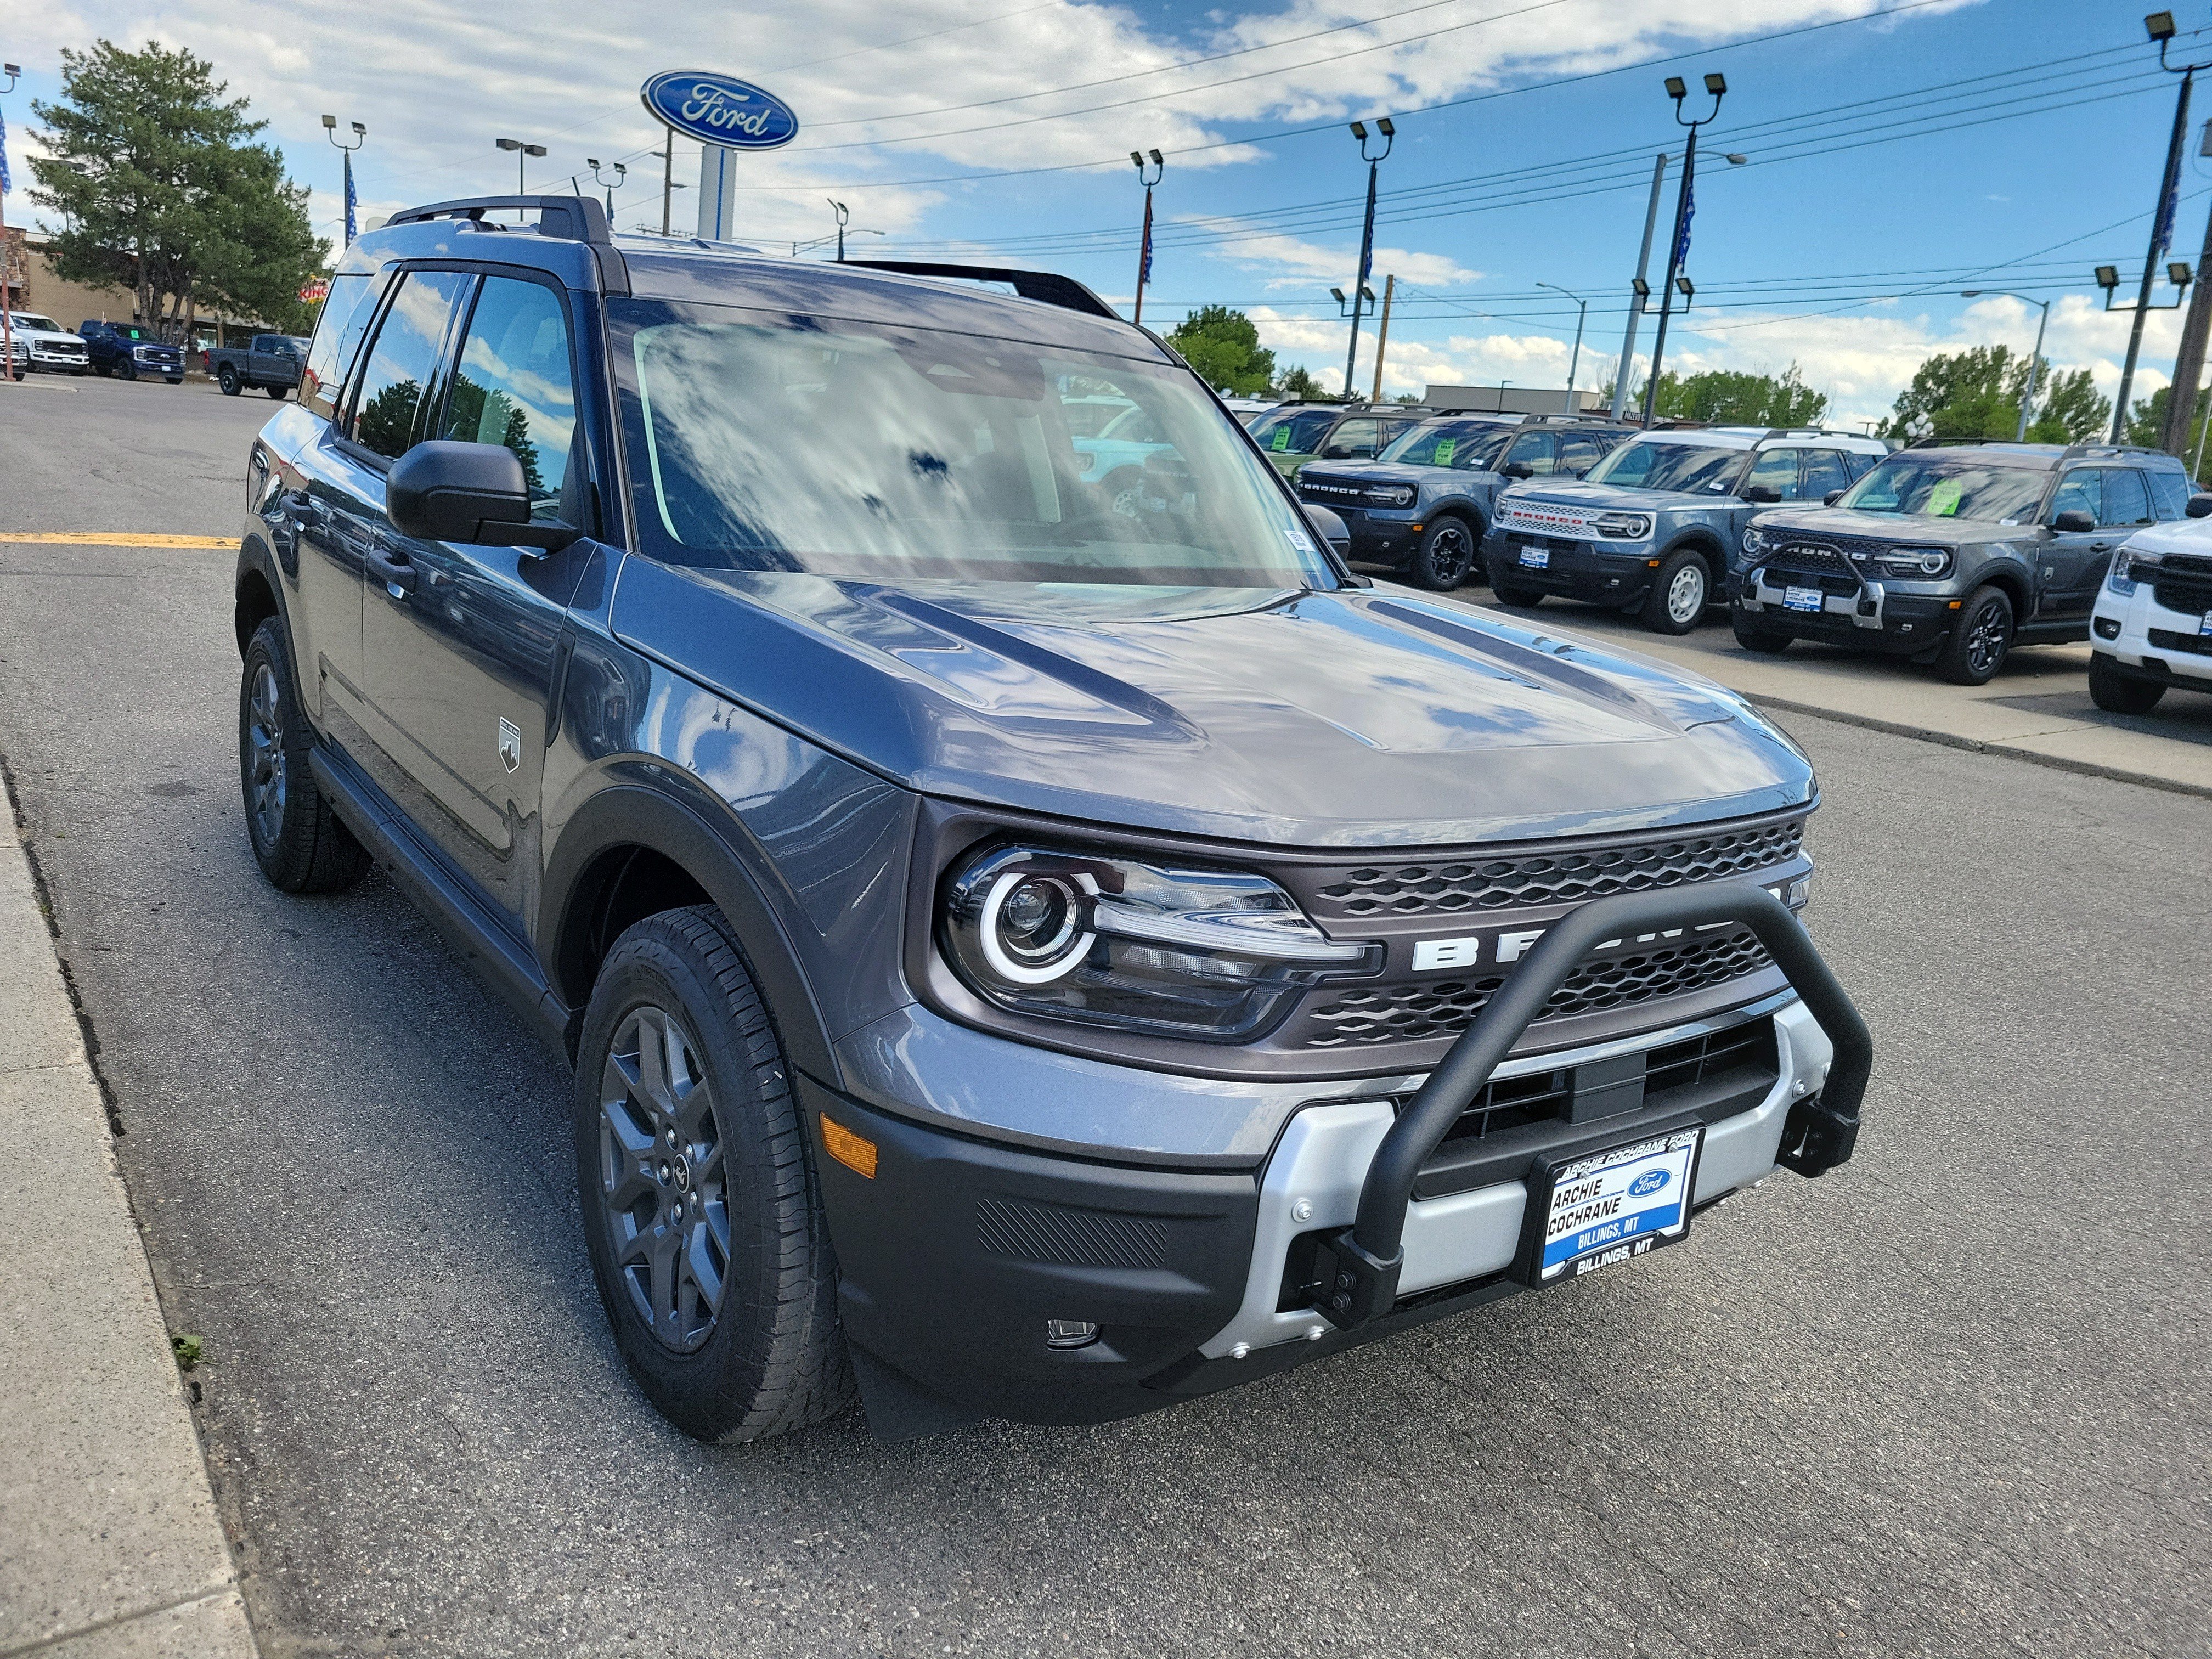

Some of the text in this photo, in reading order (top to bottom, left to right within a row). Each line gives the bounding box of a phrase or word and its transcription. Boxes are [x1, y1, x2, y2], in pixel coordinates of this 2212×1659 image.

[682, 83, 771, 136] Ford
[1513, 511, 1582, 524] BRONCO
[1562, 1130, 1700, 1178] ARCHIE COCHRANE FORD
[1551, 1178, 1603, 1211] ARCHIE
[1635, 1173, 1661, 1194] Ford
[1548, 1197, 1622, 1237] COCHRANE
[1578, 1216, 1640, 1249] BILLINGS, MT
[1577, 1238, 1654, 1276] BILLINGS, MT
